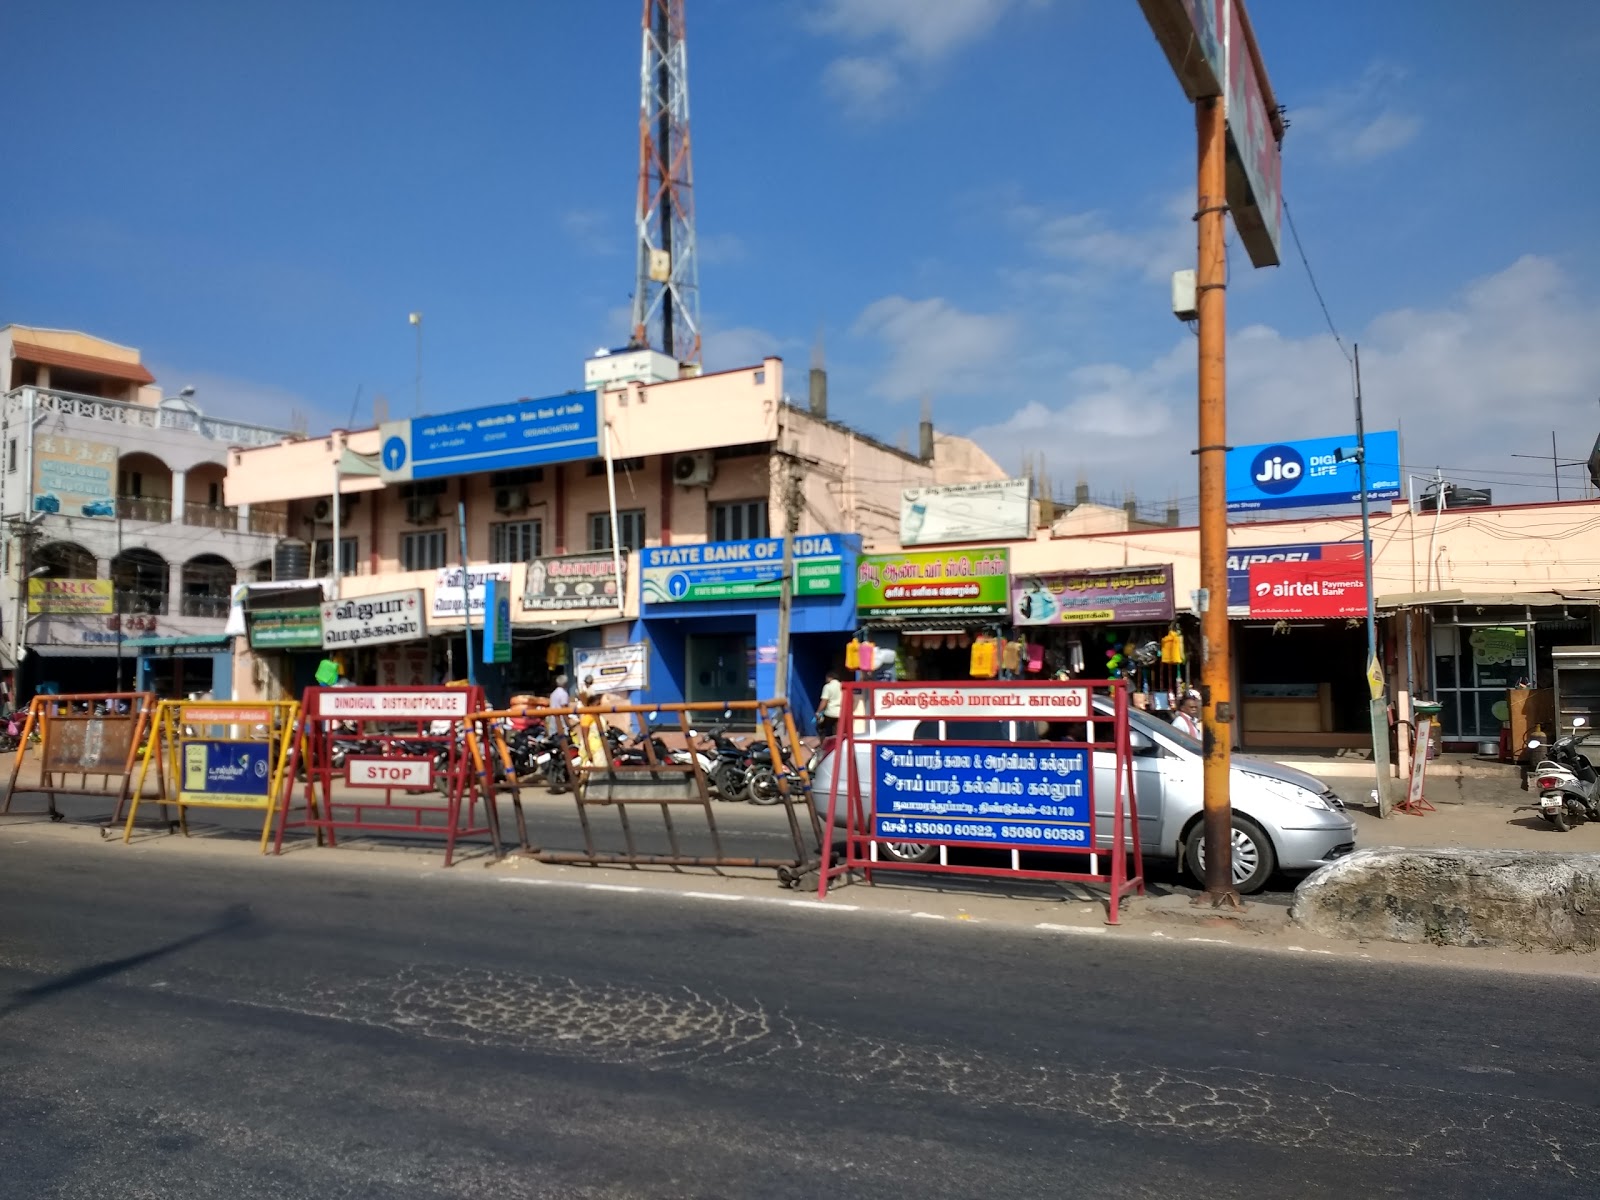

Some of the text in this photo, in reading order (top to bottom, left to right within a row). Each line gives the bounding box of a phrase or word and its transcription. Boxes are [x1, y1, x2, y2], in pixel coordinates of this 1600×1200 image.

[1256, 457, 1302, 482] Jio
[1310, 466, 1338, 477] LIFE
[650, 538, 833, 565] STATE BANK OF NDIA
[883, 559, 942, 584] ஆண்டவர்
[945, 555, 1006, 577] ஸ்டோர்ஸ்
[45, 582, 96, 593] PRK
[1273, 581, 1320, 597] airtel
[1322, 580, 1364, 589] Payments
[1322, 588, 1345, 596] Bank
[336, 599, 404, 621] விஜயா
[325, 616, 418, 643] மெடிக்கல்ஸ்
[334, 697, 457, 710] DINDIGUL DISTRICT POLICE
[881, 690, 1082, 710] திண்டுக்கல் மாவட்ட காவல்
[915, 750, 942, 770] பாரத்
[944, 755, 972, 769] கலை
[973, 754, 983, 769] &
[984, 752, 1037, 773] அறிவியல்
[1040, 752, 1084, 776] கல்லூரி
[367, 767, 412, 780] STOP
[925, 774, 961, 795] பாரத்
[1028, 776, 1083, 802] கல்லூரி
[1058, 807, 1075, 817] 710
[914, 822, 952, 835] 85080
[954, 824, 997, 839] 60522,
[1001, 826, 1042, 839] 85080
[1043, 828, 1085, 841] 60533
